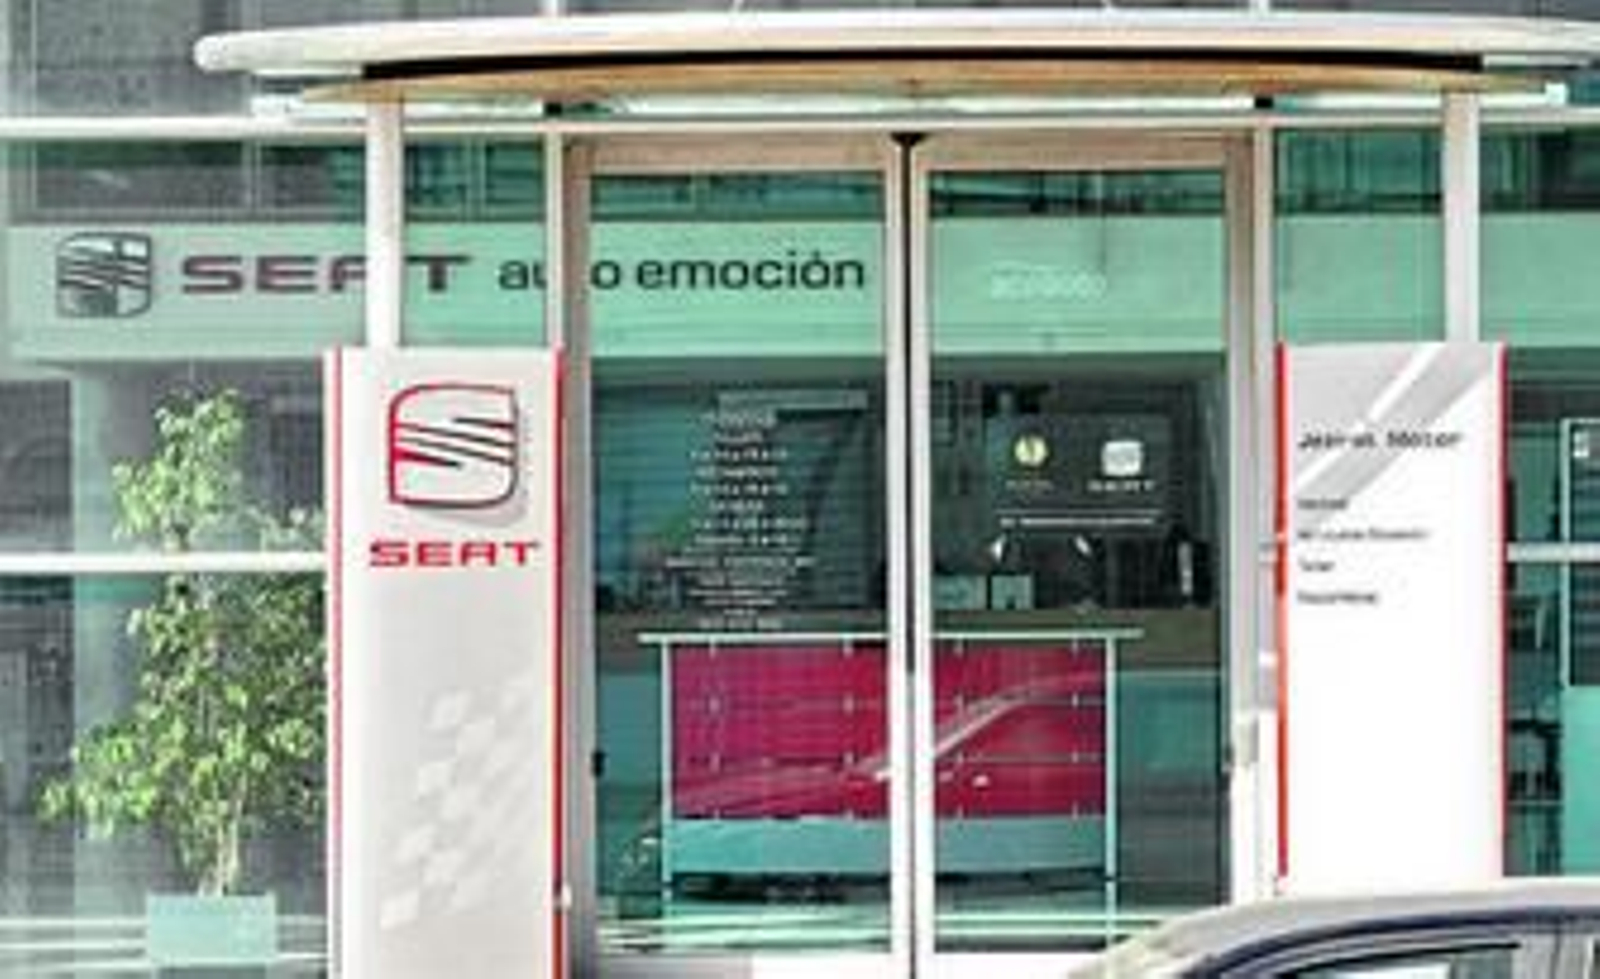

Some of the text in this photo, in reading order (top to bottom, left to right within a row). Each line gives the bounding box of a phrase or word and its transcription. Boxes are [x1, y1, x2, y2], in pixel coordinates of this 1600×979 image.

[498, 259, 621, 291] auo
[636, 250, 864, 291] emoción
[369, 541, 541, 568] SEAT
